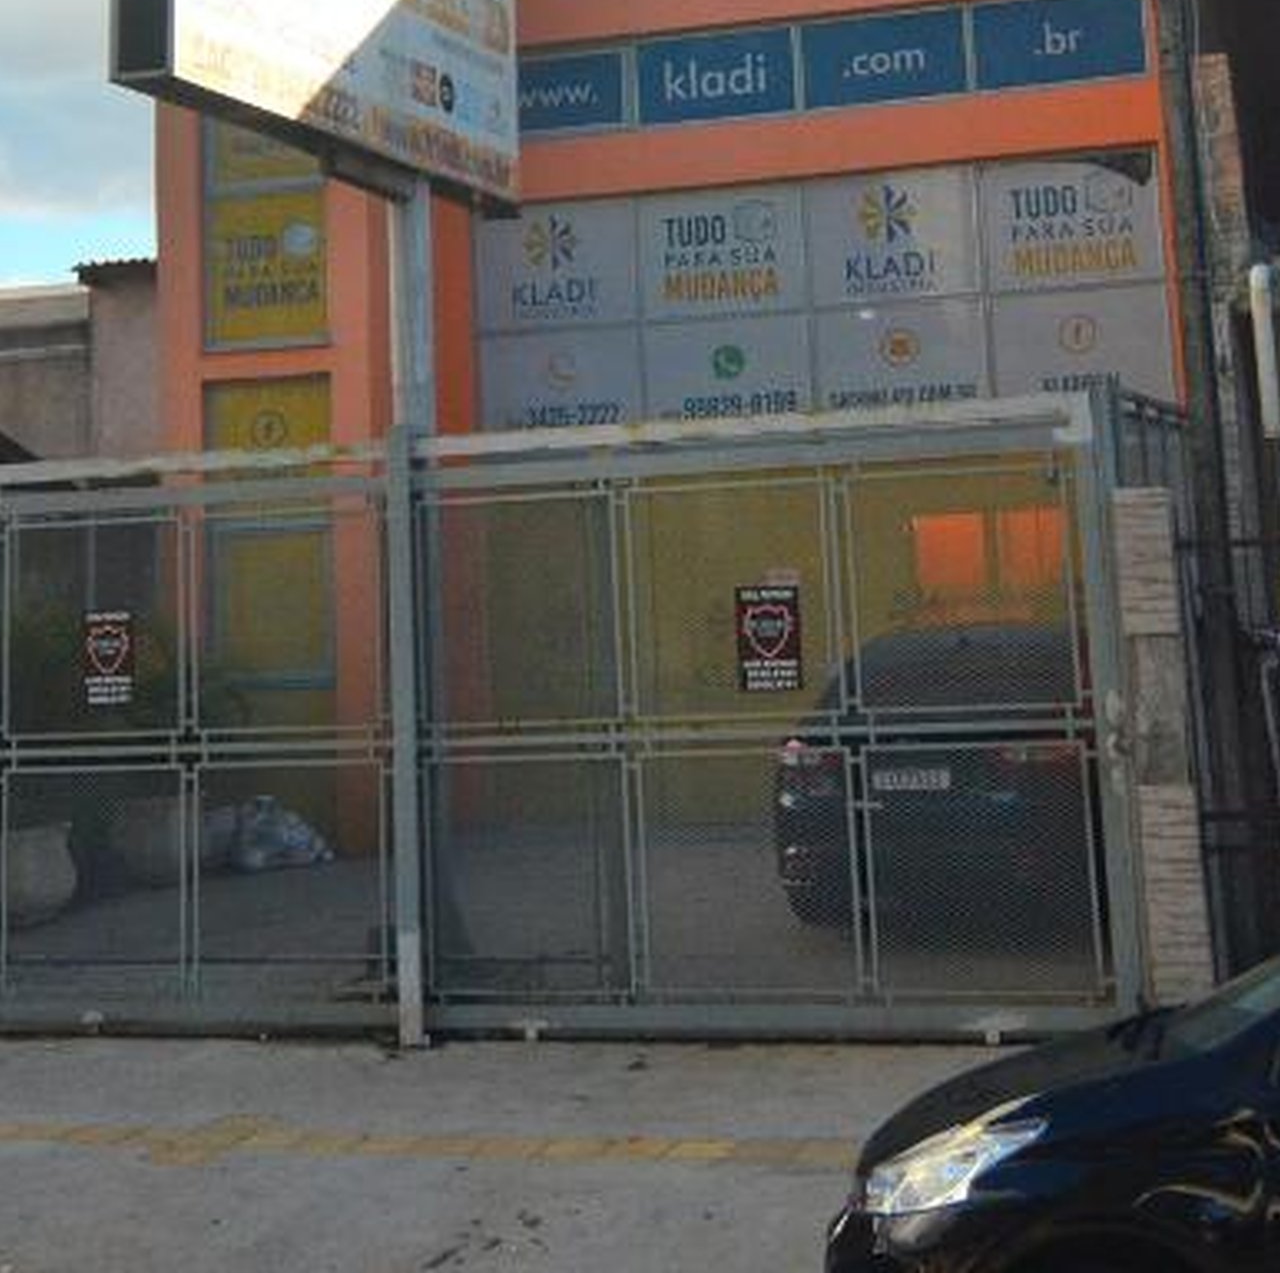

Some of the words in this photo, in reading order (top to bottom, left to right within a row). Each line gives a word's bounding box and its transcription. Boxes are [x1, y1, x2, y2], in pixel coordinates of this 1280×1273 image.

[663, 52, 766, 100] kladi
[842, 48, 926, 78] .com
[1033, 21, 1081, 56] .br
[1010, 186, 1077, 219] TUDO
[661, 215, 727, 249] TUDO
[845, 250, 935, 280] KLADI
[513, 278, 597, 309] KLADI
